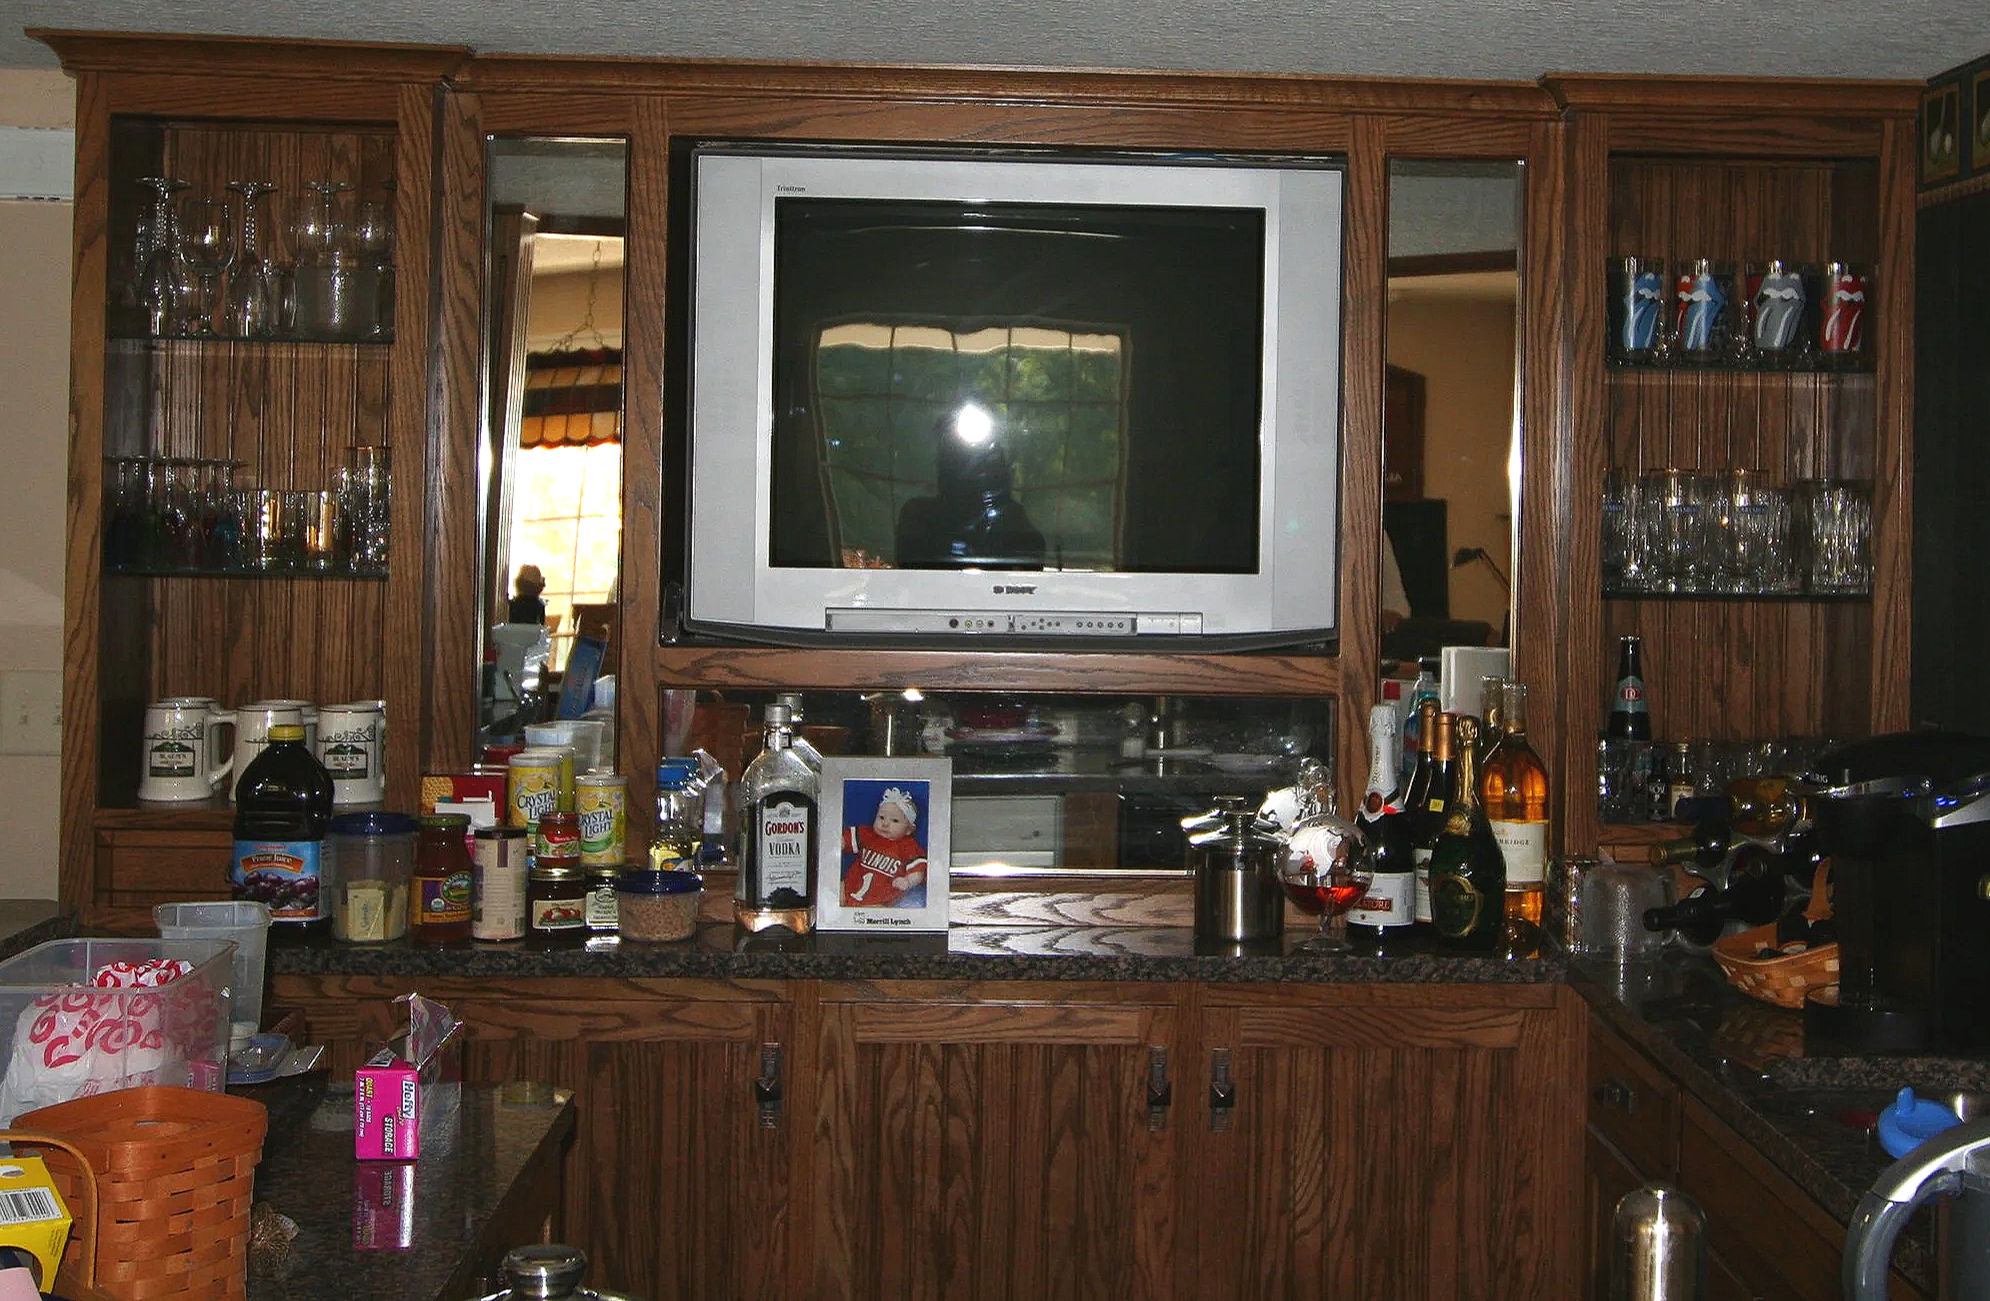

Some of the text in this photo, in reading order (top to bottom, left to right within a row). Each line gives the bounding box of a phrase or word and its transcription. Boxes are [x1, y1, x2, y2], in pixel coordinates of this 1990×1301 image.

[580, 809, 614, 827] RYSTAL
[584, 820, 612, 839] LIGHT
[765, 821, 804, 836] GORDON'S
[769, 842, 801, 856] VODKA
[890, 917, 911, 926] Lynch
[403, 1082, 414, 1118] Hefty
[384, 1116, 393, 1154] STORAGE
